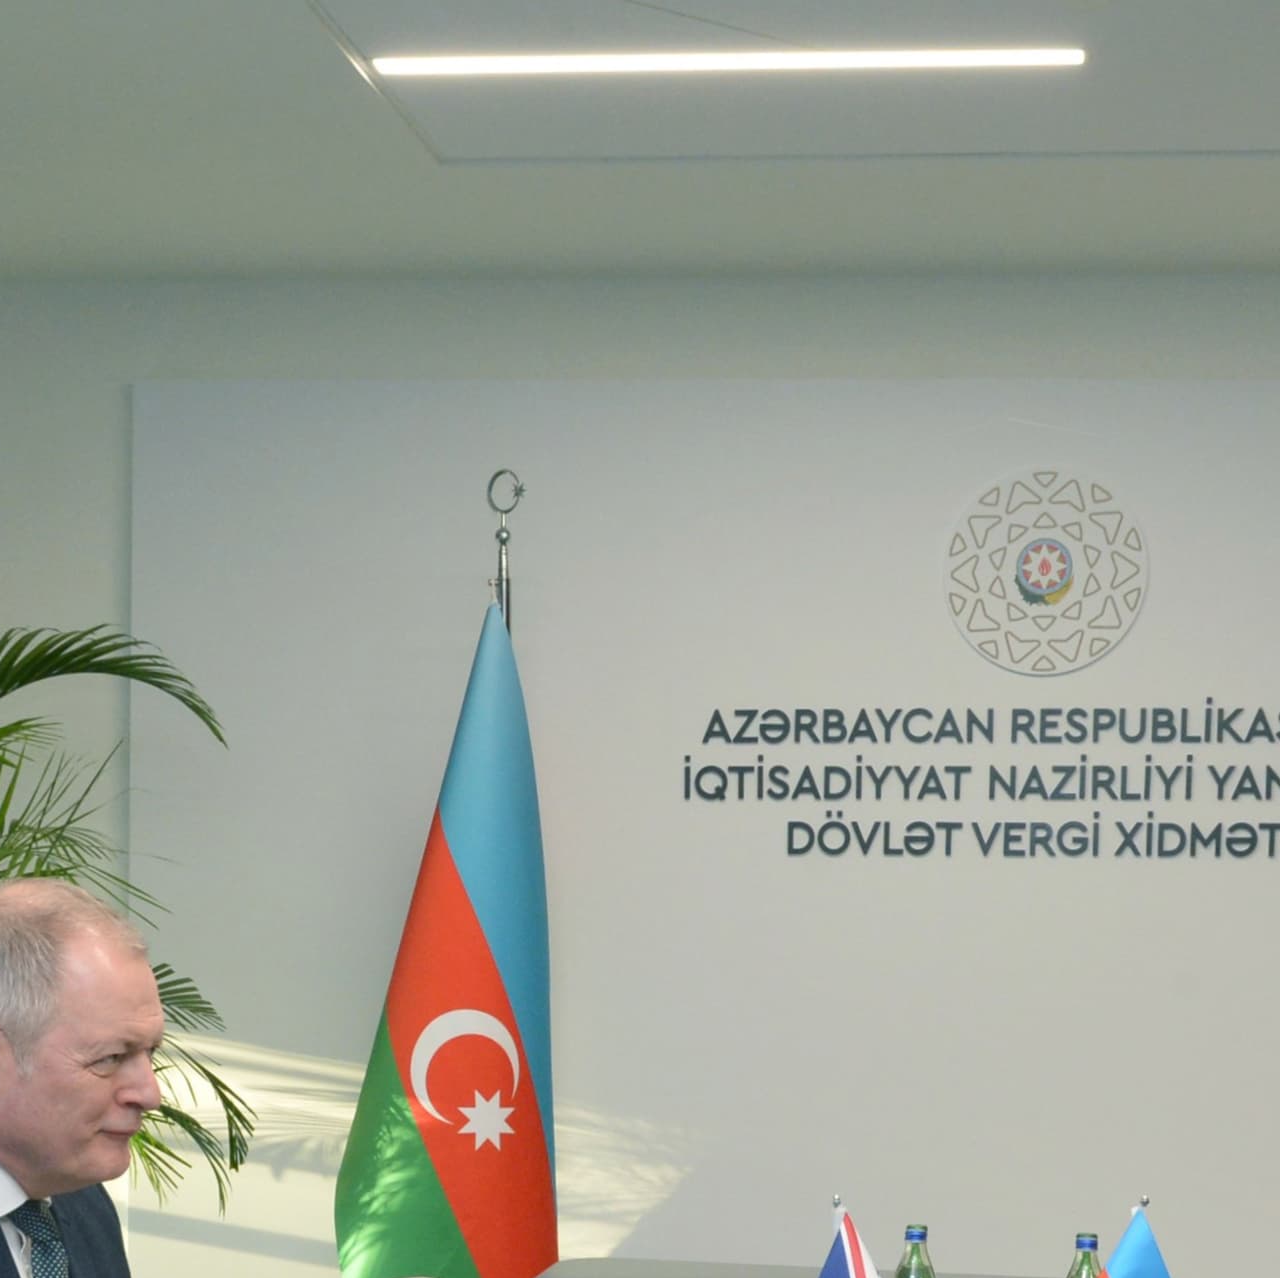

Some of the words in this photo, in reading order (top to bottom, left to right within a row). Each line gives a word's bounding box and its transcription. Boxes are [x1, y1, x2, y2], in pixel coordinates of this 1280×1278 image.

[701, 707, 994, 744] AZƏRBAYCAN
[683, 753, 972, 801] İQTİSADİYYAT
[988, 753, 1194, 801] NAZİRLİYİ
[786, 810, 964, 857] DÖVLƏT
[970, 810, 1101, 857] VERGİ
